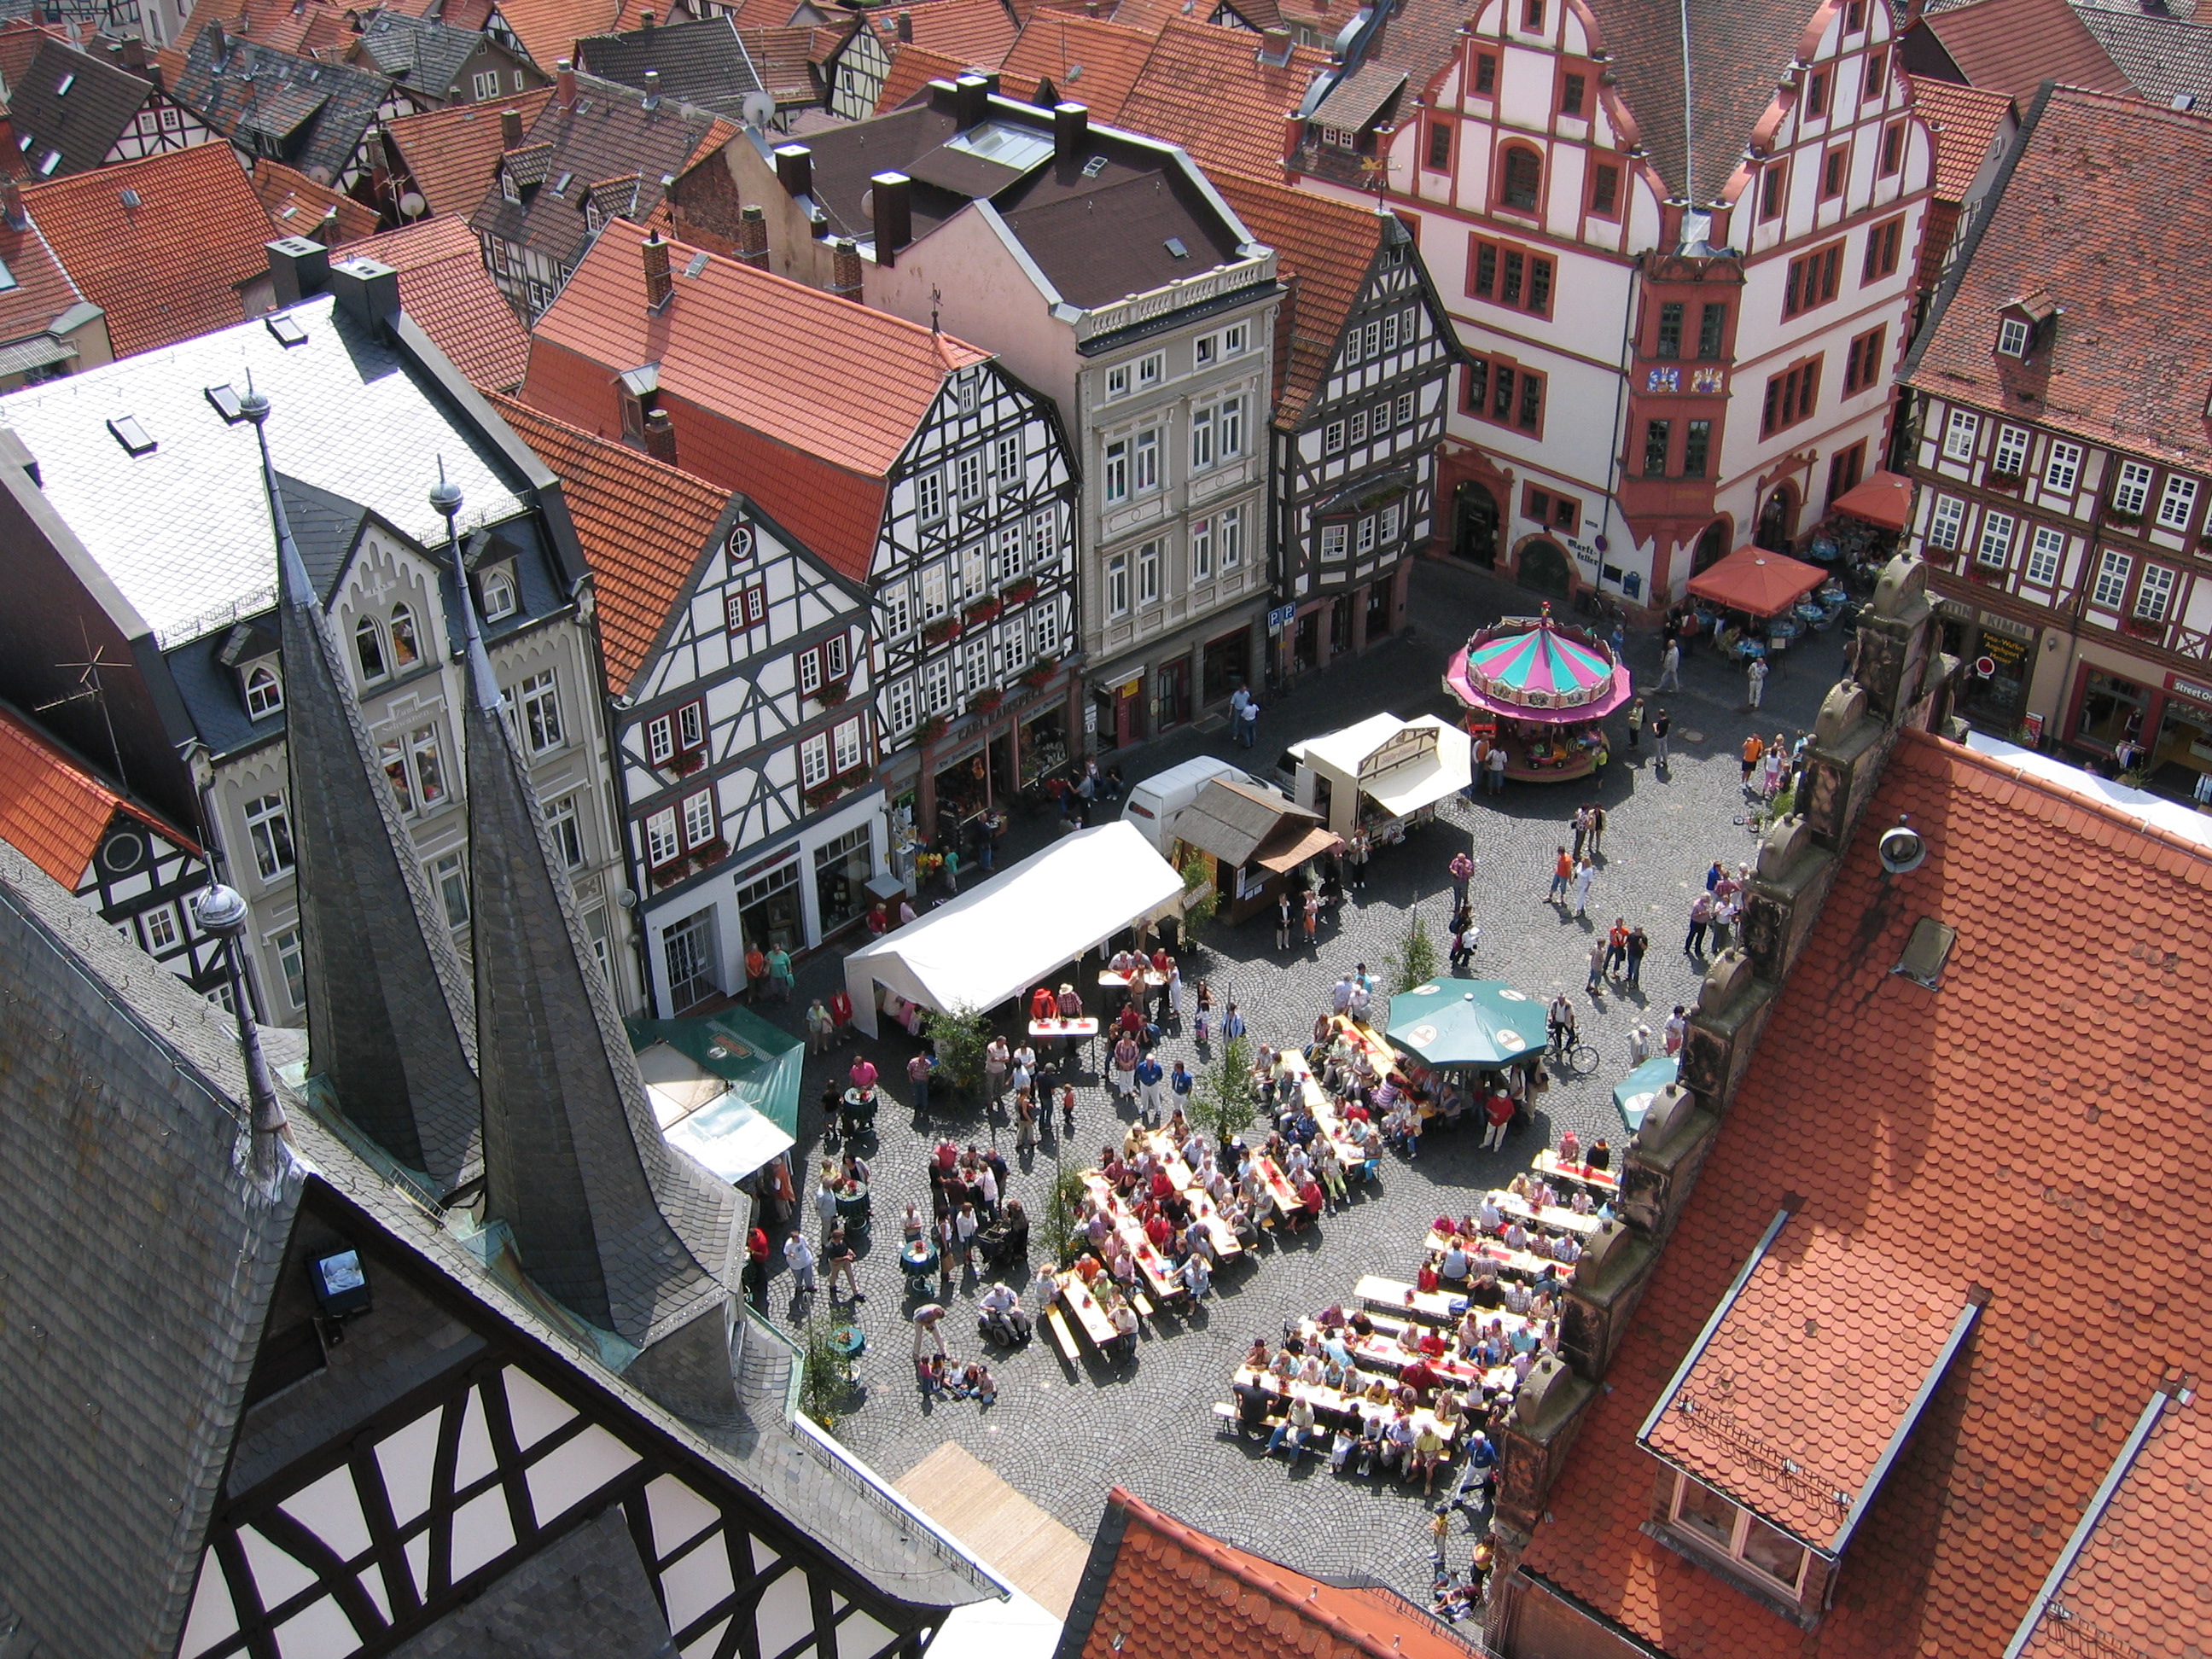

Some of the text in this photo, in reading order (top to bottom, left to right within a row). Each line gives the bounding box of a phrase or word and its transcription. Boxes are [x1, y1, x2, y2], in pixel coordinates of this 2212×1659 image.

[1285, 606, 1293, 618] P
[1271, 613, 1278, 625] P
[1988, 614, 2027, 637] KIMM
